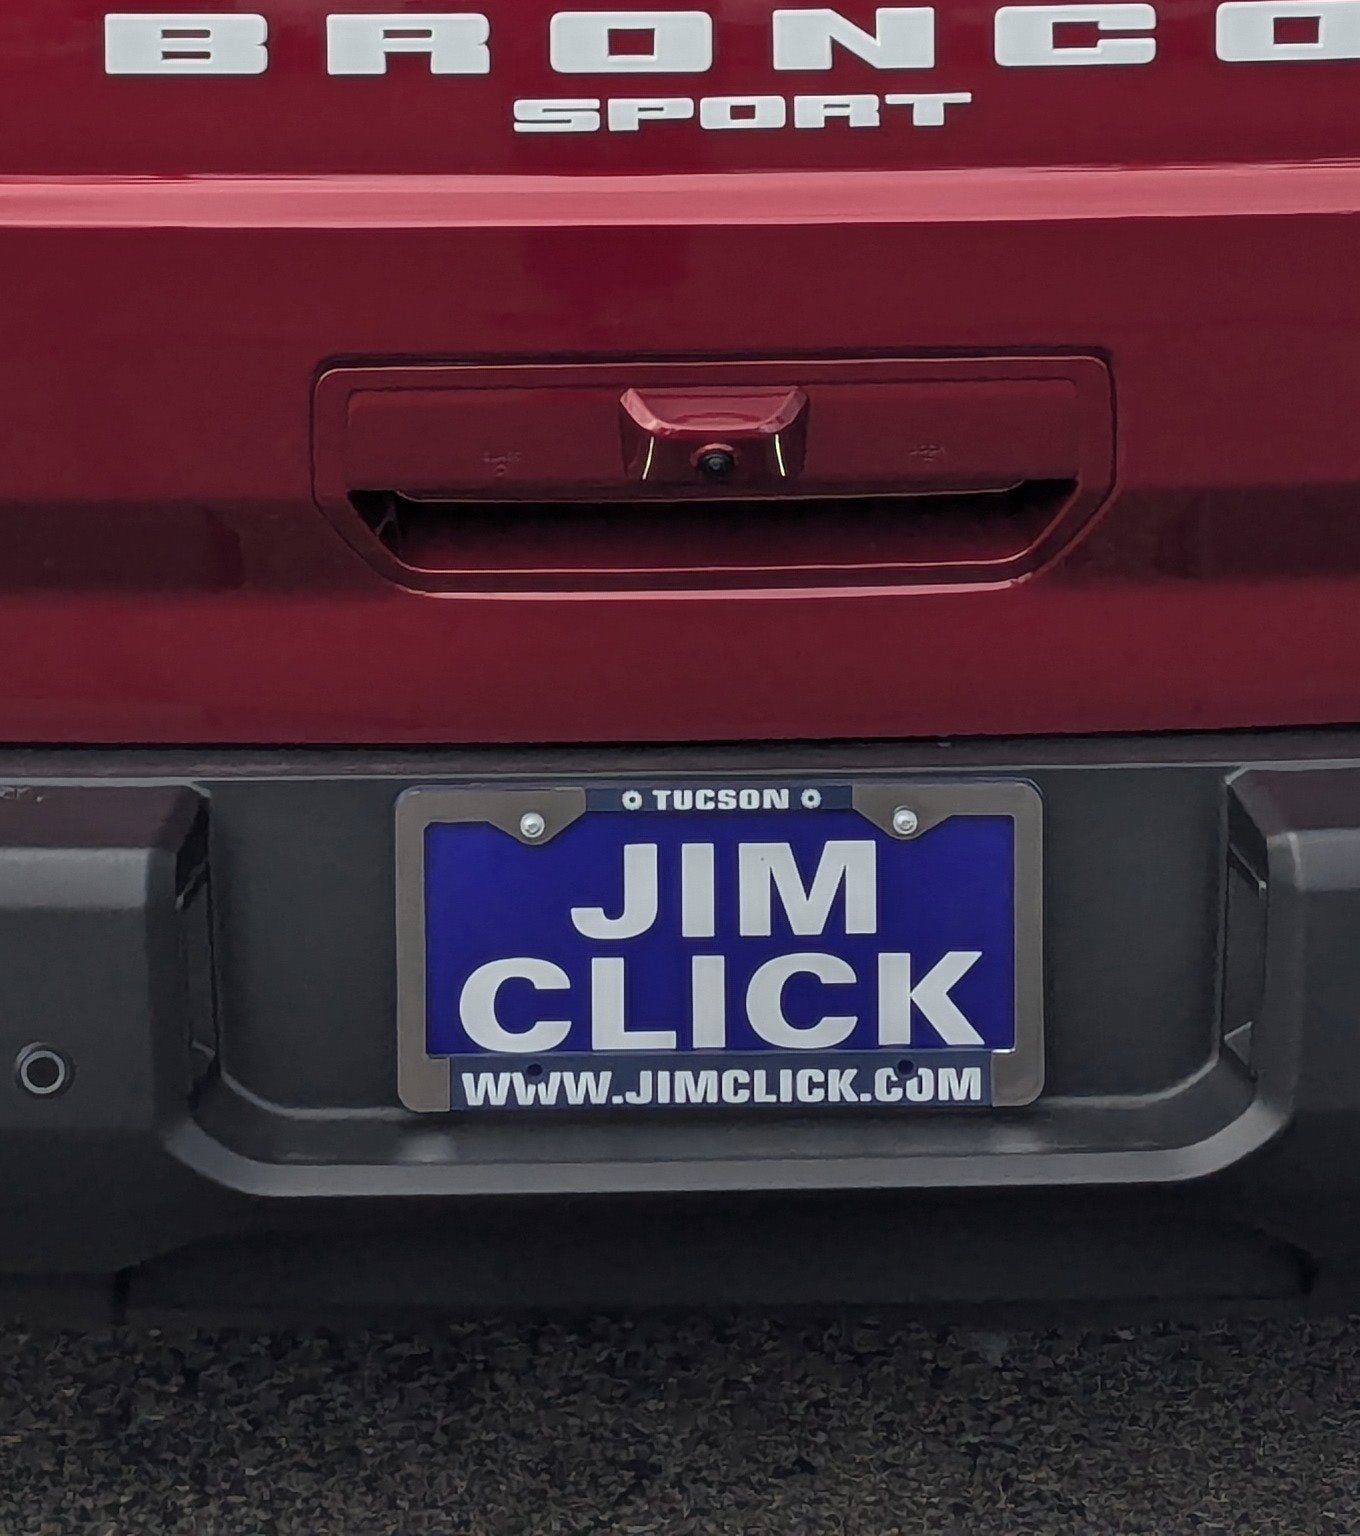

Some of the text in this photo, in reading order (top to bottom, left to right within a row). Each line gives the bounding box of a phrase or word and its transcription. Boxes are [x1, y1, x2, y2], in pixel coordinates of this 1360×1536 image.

[513, 92, 973, 133] SPORT
[652, 788, 790, 811] TUCSON
[570, 839, 878, 940] JIM
[459, 950, 986, 1054] CLICK
[461, 1067, 983, 1106] WWW.JIMCLICK.COM
